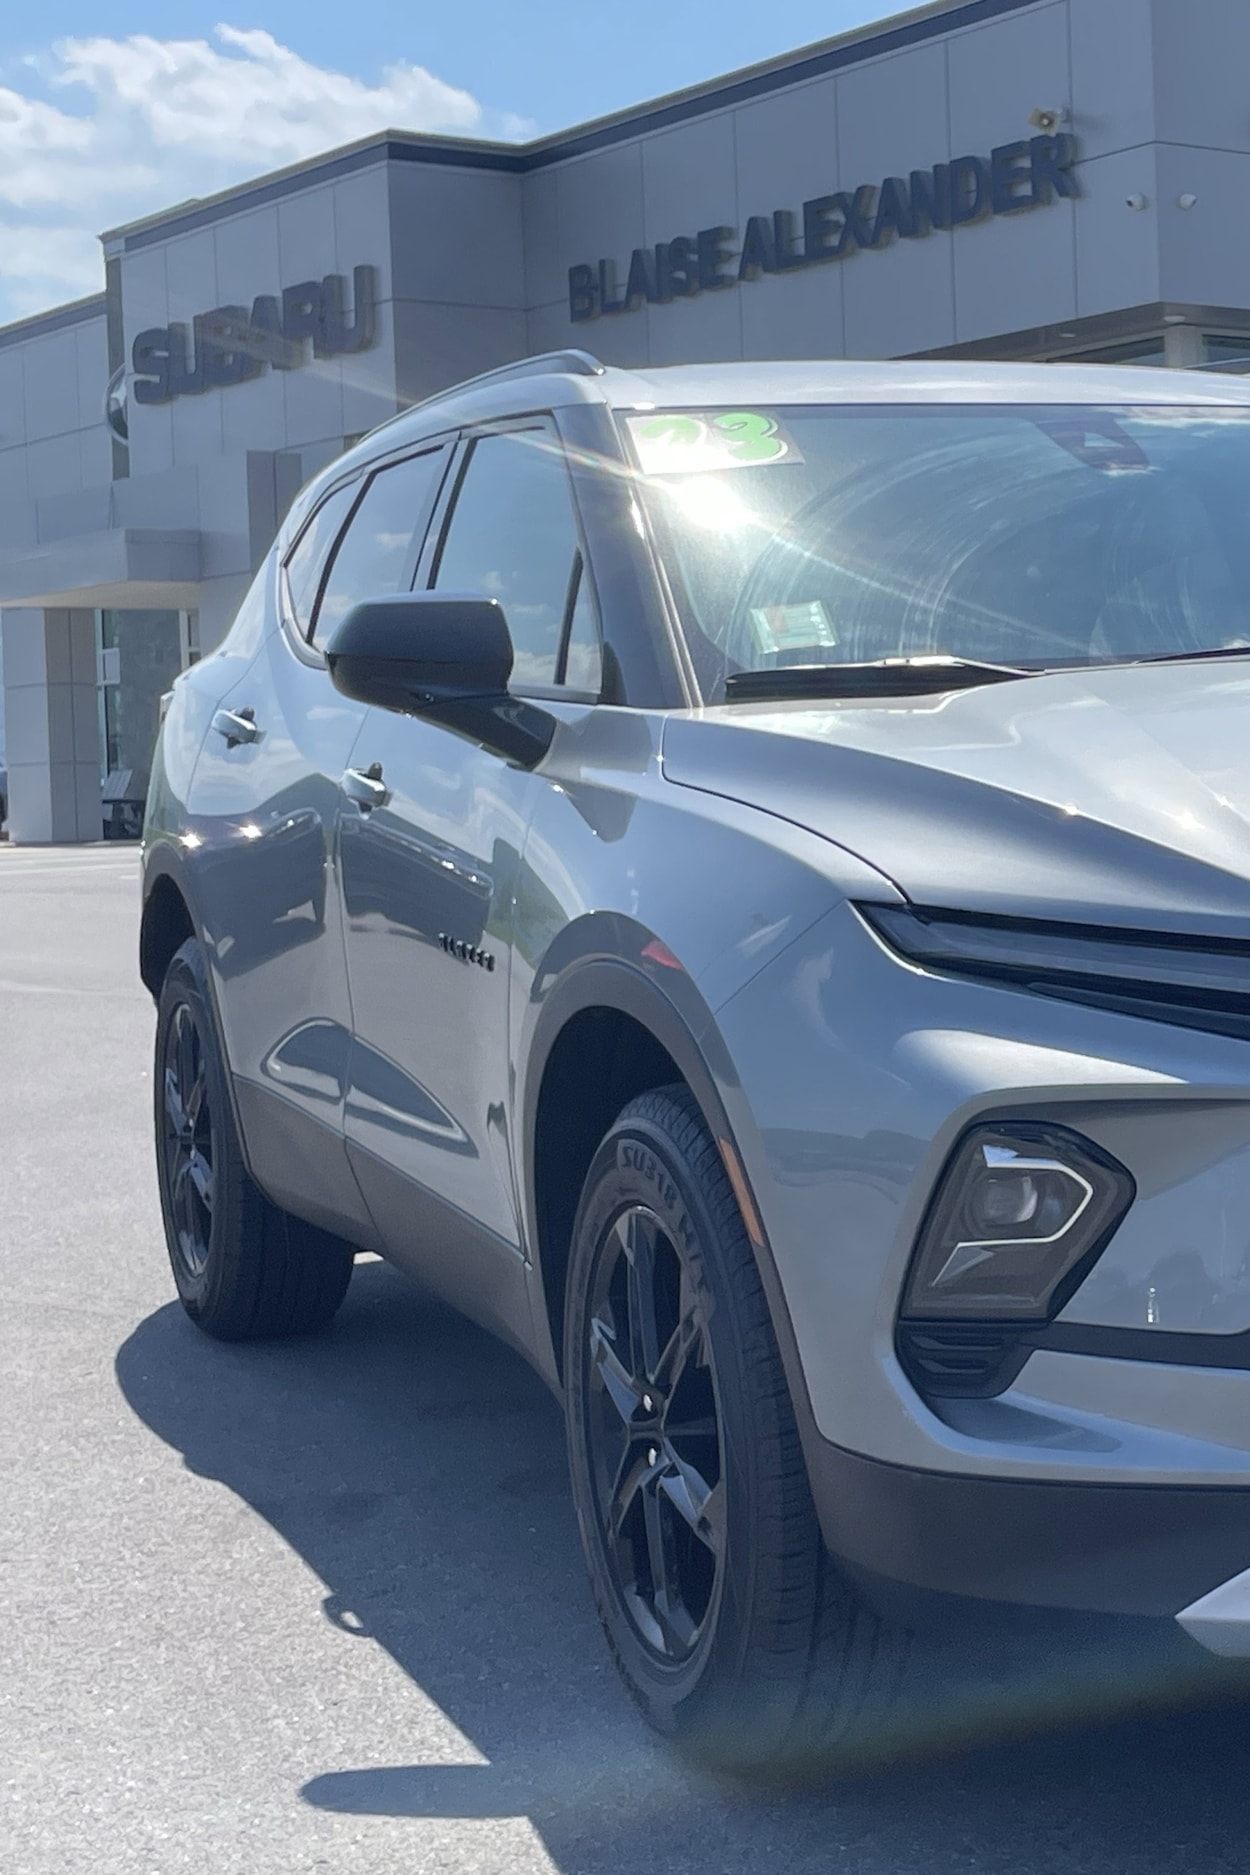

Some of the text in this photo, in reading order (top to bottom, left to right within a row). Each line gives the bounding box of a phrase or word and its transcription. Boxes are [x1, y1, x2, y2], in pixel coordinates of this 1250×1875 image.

[568, 132, 1083, 323] BLAISE ALEXANDER
[132, 264, 379, 405] SUBARU
